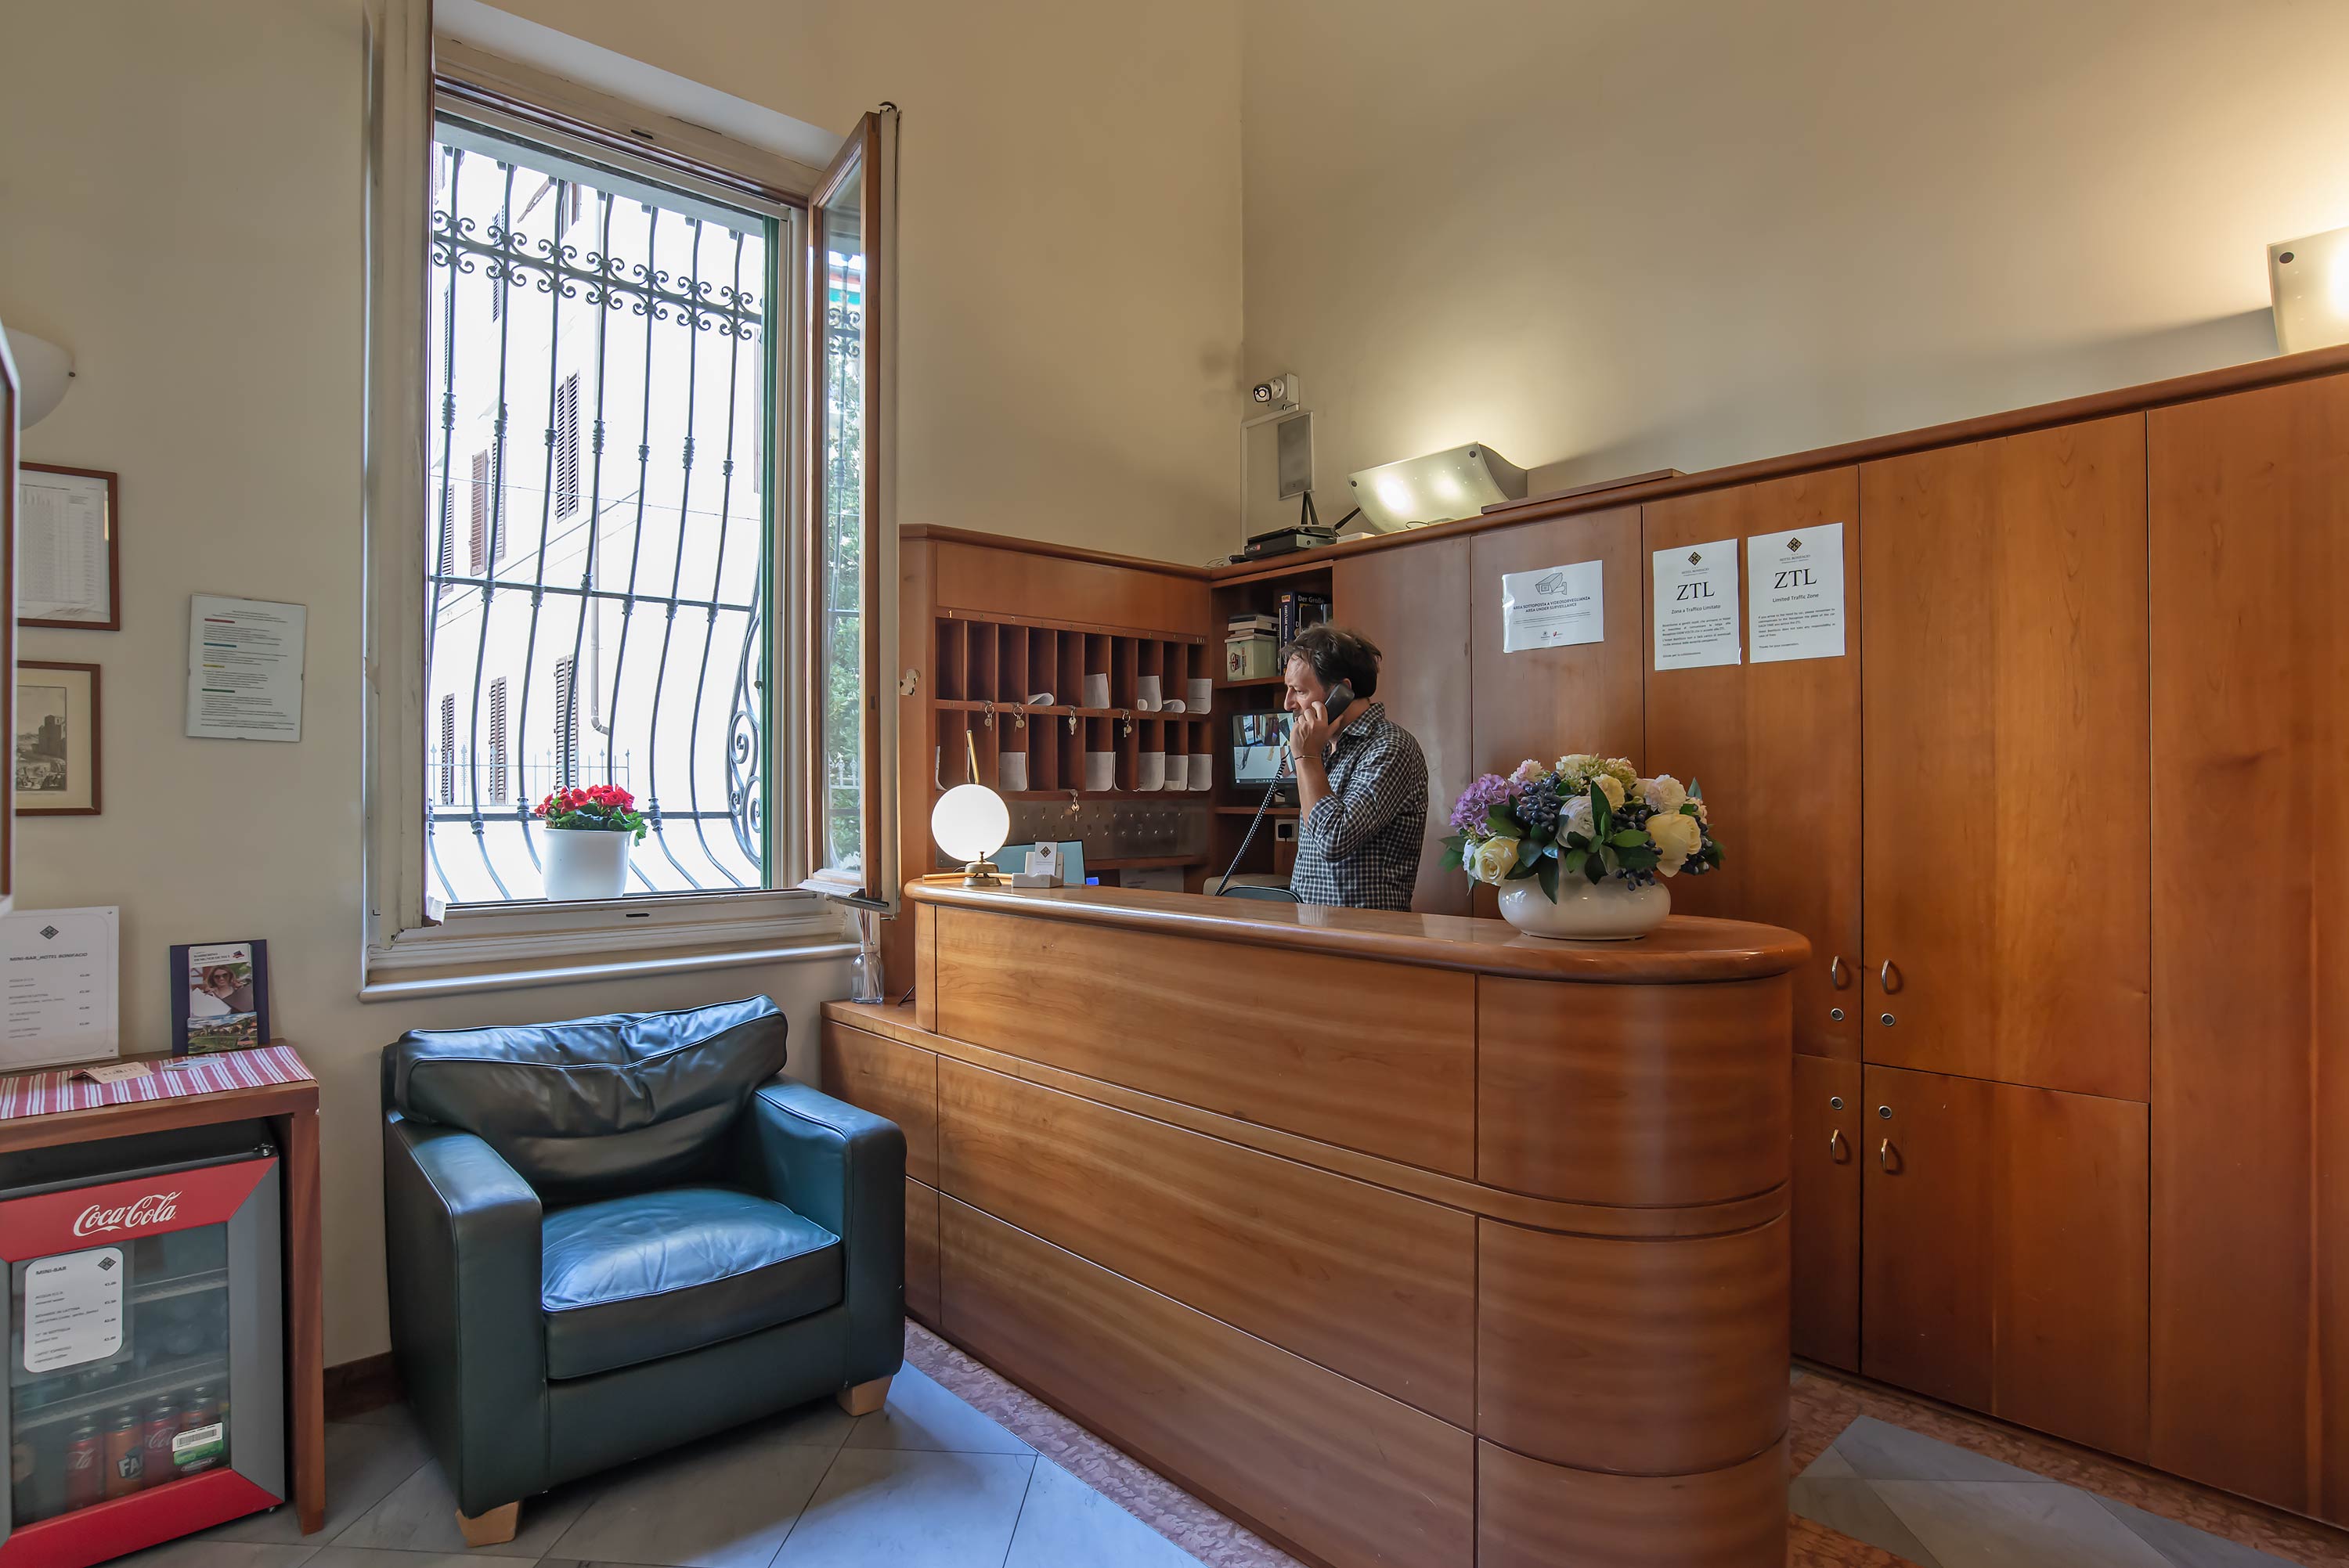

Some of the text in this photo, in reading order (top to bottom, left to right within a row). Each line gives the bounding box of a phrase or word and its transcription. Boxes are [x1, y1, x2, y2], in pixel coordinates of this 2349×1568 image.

[1774, 568, 1817, 589] ZTL
[1676, 582, 1715, 600] ZTL
[73, 1190, 182, 1237] Coca-Cola
[36, 1266, 67, 1275] MINI-BAR
